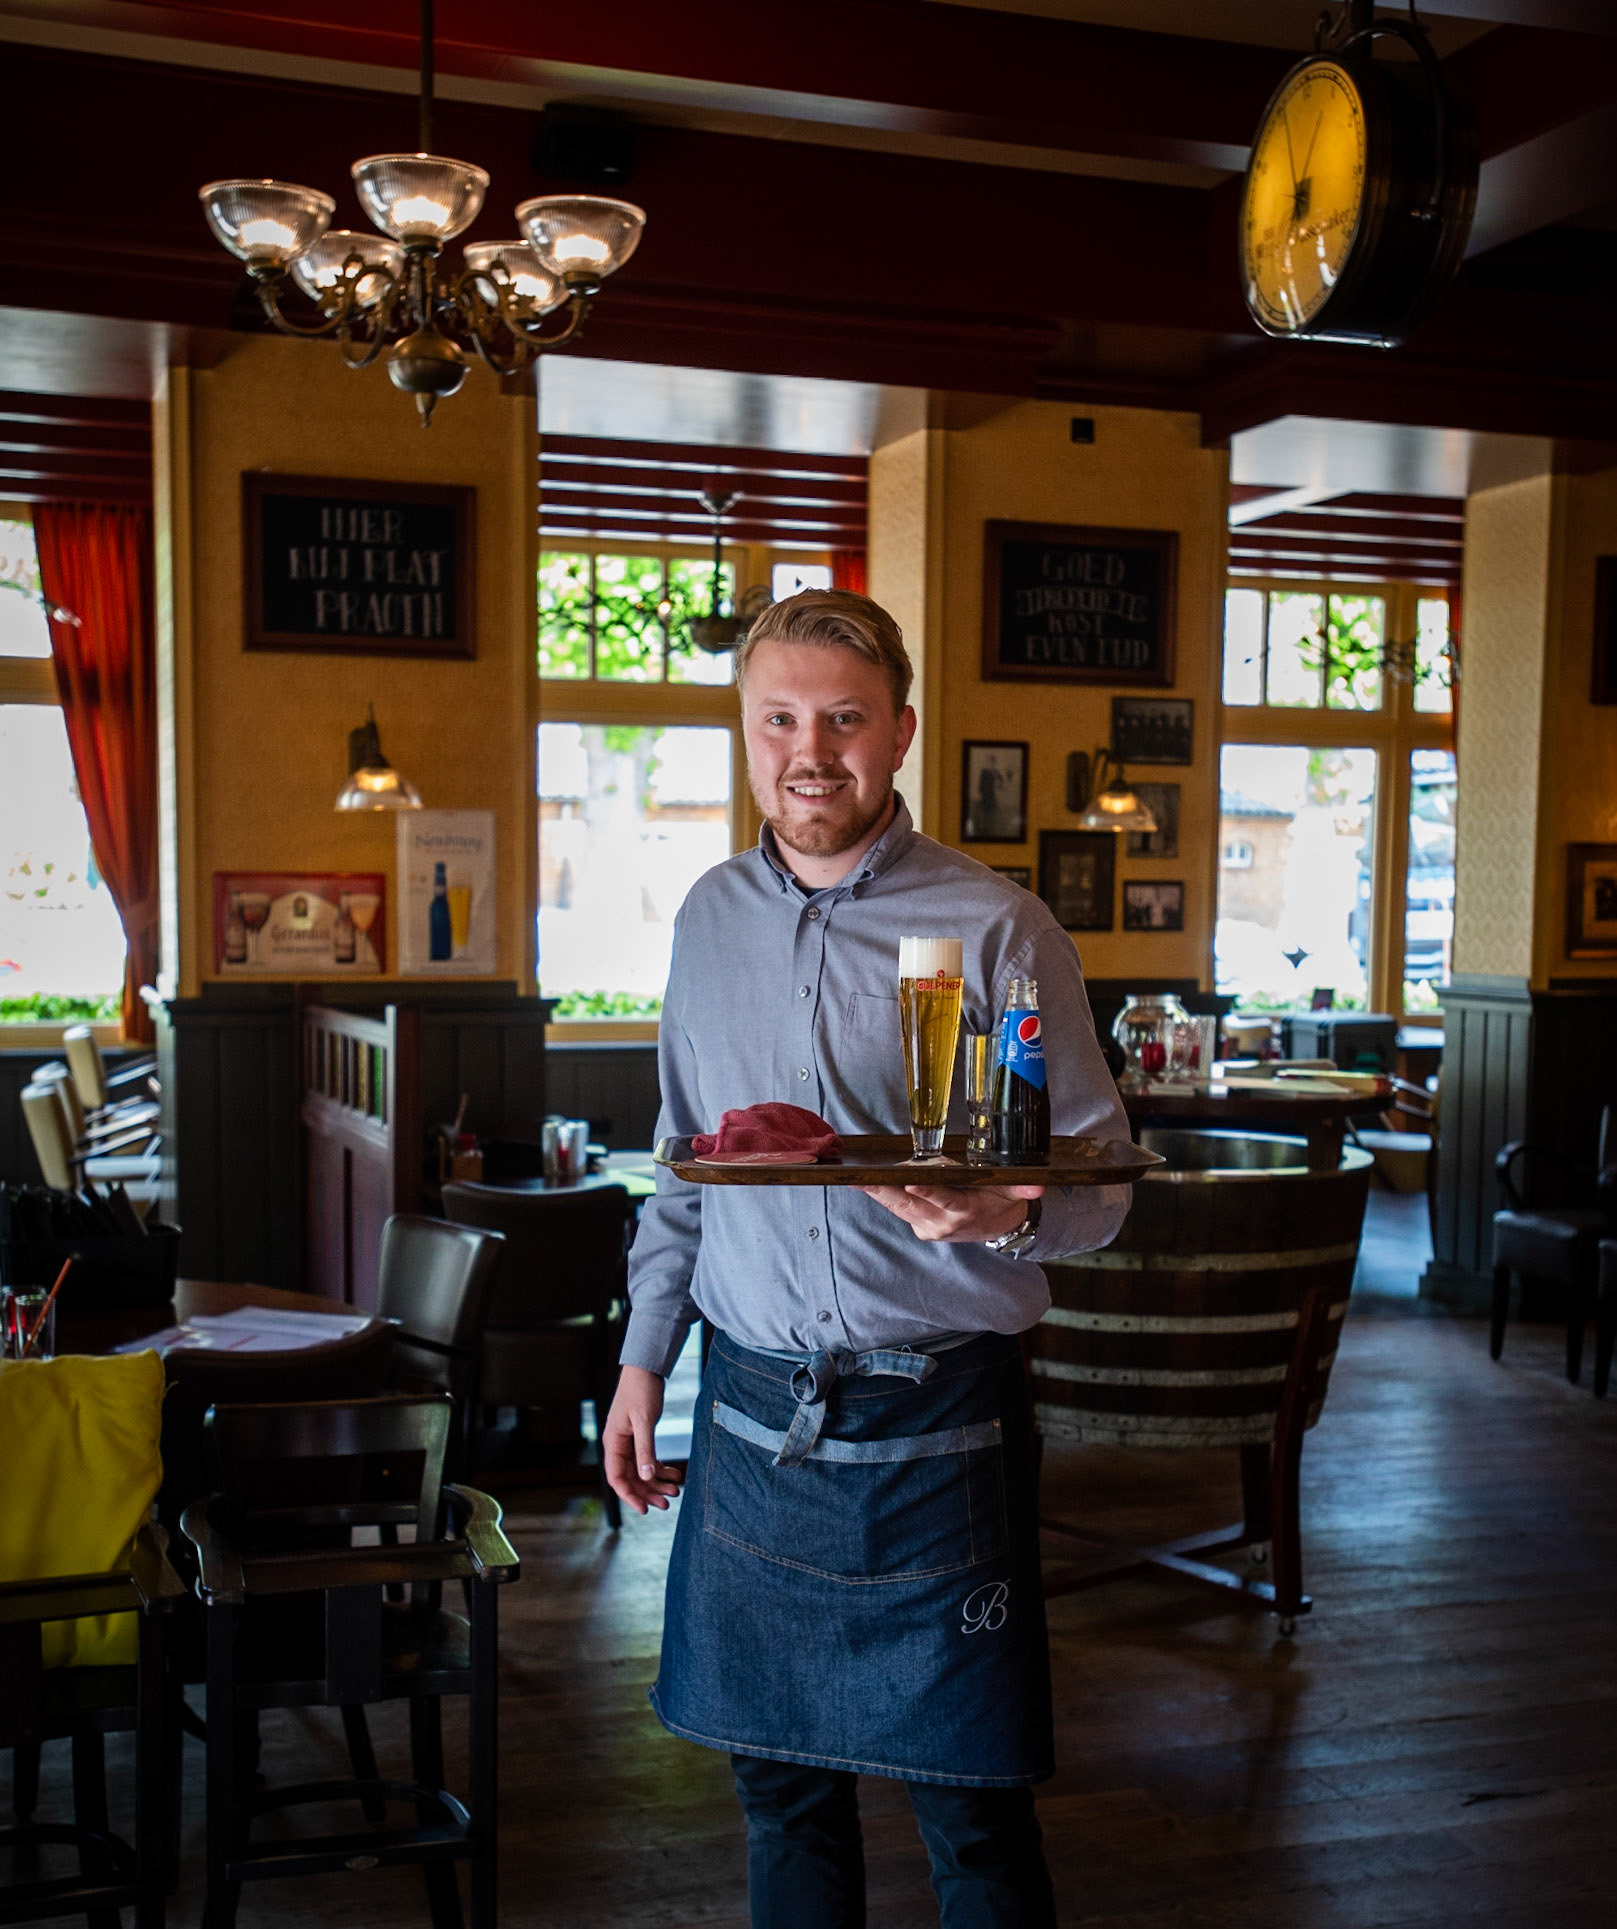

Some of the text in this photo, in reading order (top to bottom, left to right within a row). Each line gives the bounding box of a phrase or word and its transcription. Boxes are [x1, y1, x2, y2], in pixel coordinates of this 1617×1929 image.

[321, 507, 404, 545] HIER
[362, 547, 448, 587] PLAT
[1043, 551, 1126, 584] GOED
[917, 980, 960, 991] GULPENER
[1024, 1051, 1045, 1060] peps
[961, 1578, 1012, 1634] B
